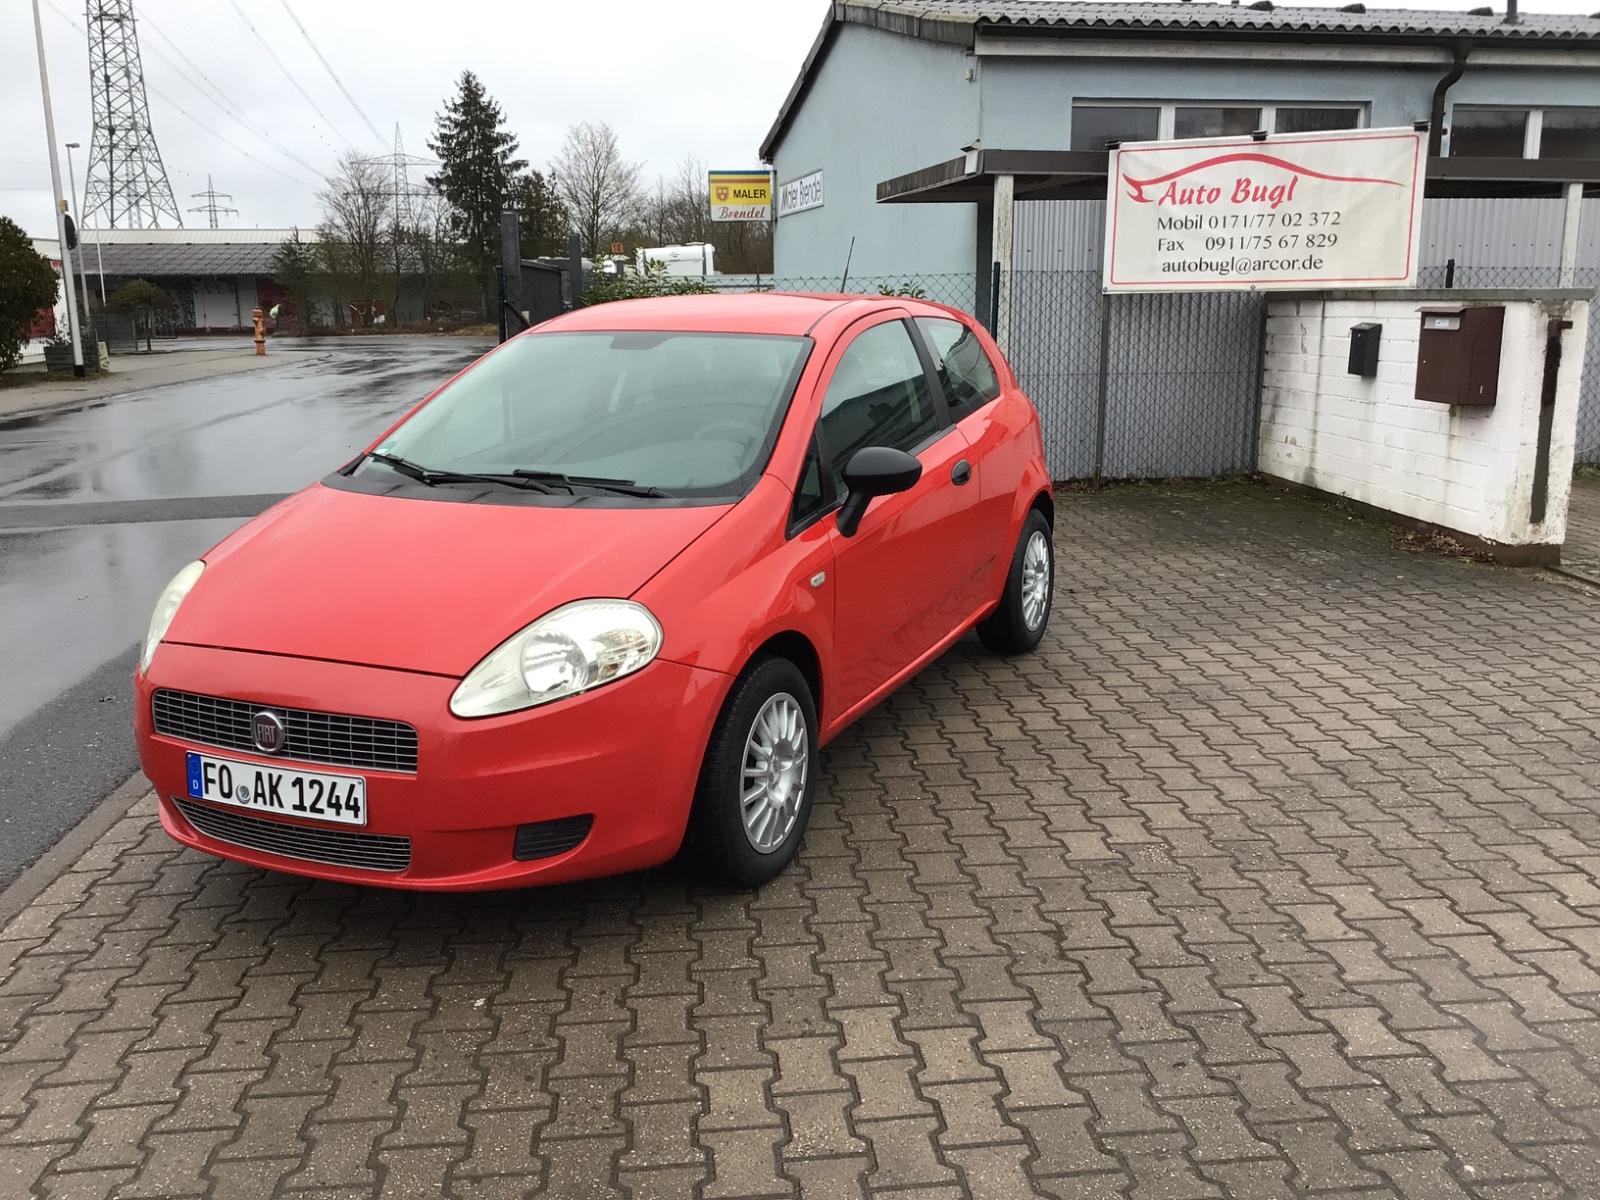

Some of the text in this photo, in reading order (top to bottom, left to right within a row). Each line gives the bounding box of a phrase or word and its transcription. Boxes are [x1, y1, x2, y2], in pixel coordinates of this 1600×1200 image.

[733, 189, 766, 199] MALER
[1158, 175, 1298, 209] Auto Bugl
[718, 206, 765, 219] Brendel
[1157, 211, 1341, 231] Mobil 0171/77 02 372
[1158, 232, 1337, 251] Fax 0911/75 67 829
[1162, 255, 1324, 276] autobugl@arcor.de
[257, 725, 277, 743] FIAT
[192, 779, 199, 790] D
[203, 761, 361, 819] FO AK 1244
